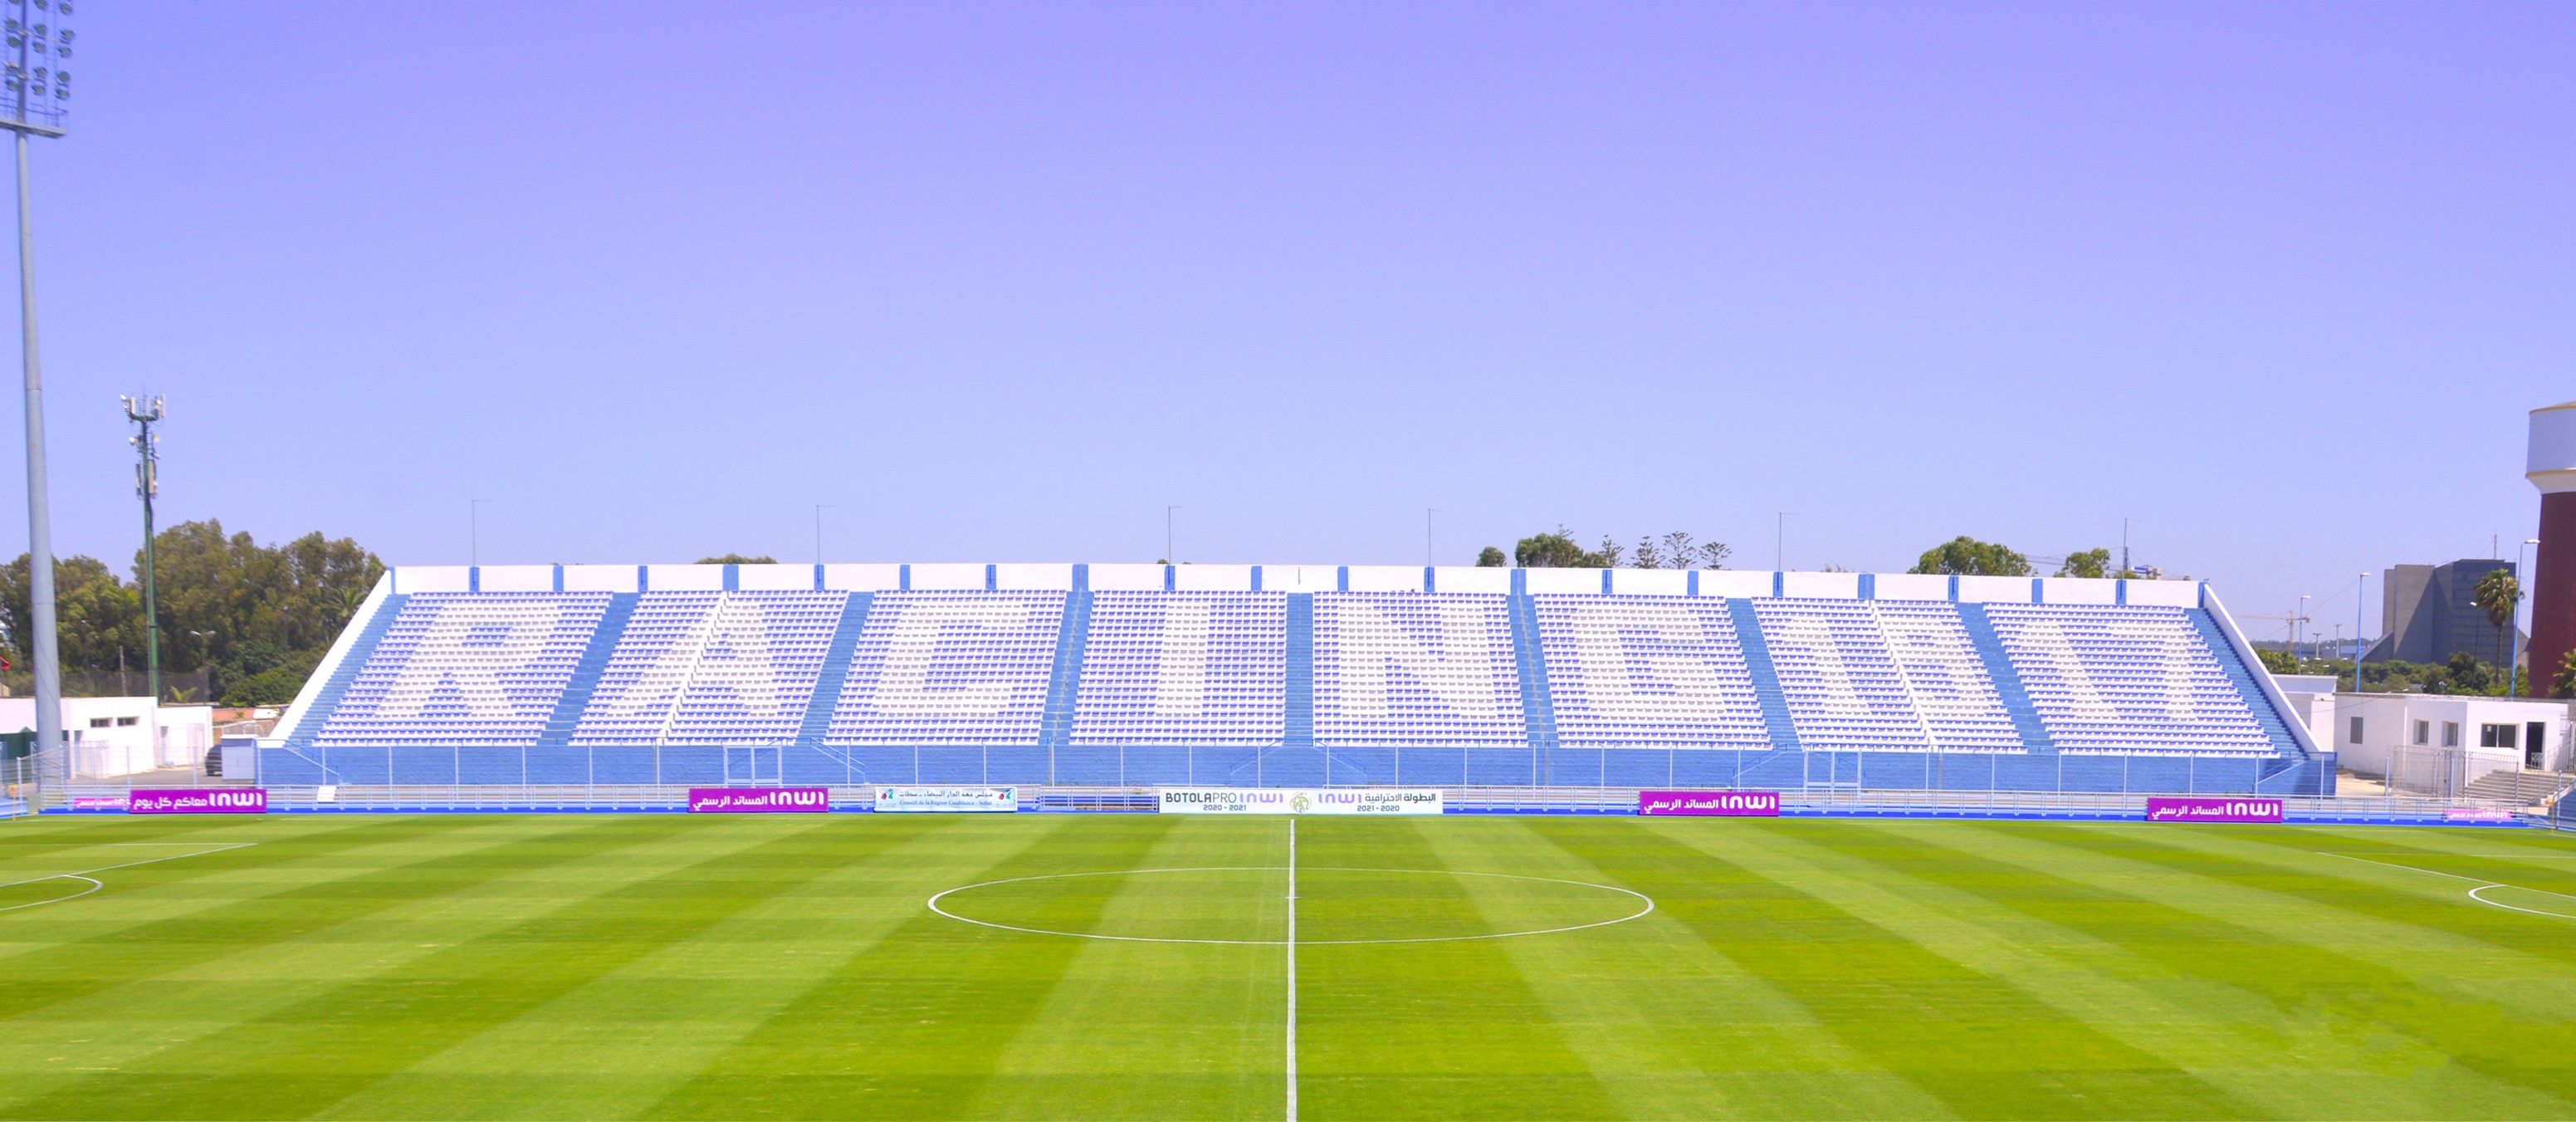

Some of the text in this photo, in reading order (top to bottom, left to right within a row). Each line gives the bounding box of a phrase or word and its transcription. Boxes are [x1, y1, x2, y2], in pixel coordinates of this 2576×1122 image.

[374, 604, 2200, 722] RACING 1917
[133, 799, 153, 811] يوم
[154, 796, 172, 810] كل
[174, 796, 208, 811] معاكم
[692, 796, 731, 811] الرسمي
[732, 795, 768, 806] المساند
[1365, 793, 1402, 804] الاحترافية
[1404, 793, 1436, 804] البطولة
[1684, 799, 1718, 809] المساند
[1644, 799, 1682, 814] الرسمي
[2151, 806, 2188, 820] الرسمي
[2190, 806, 2224, 816] المساند
